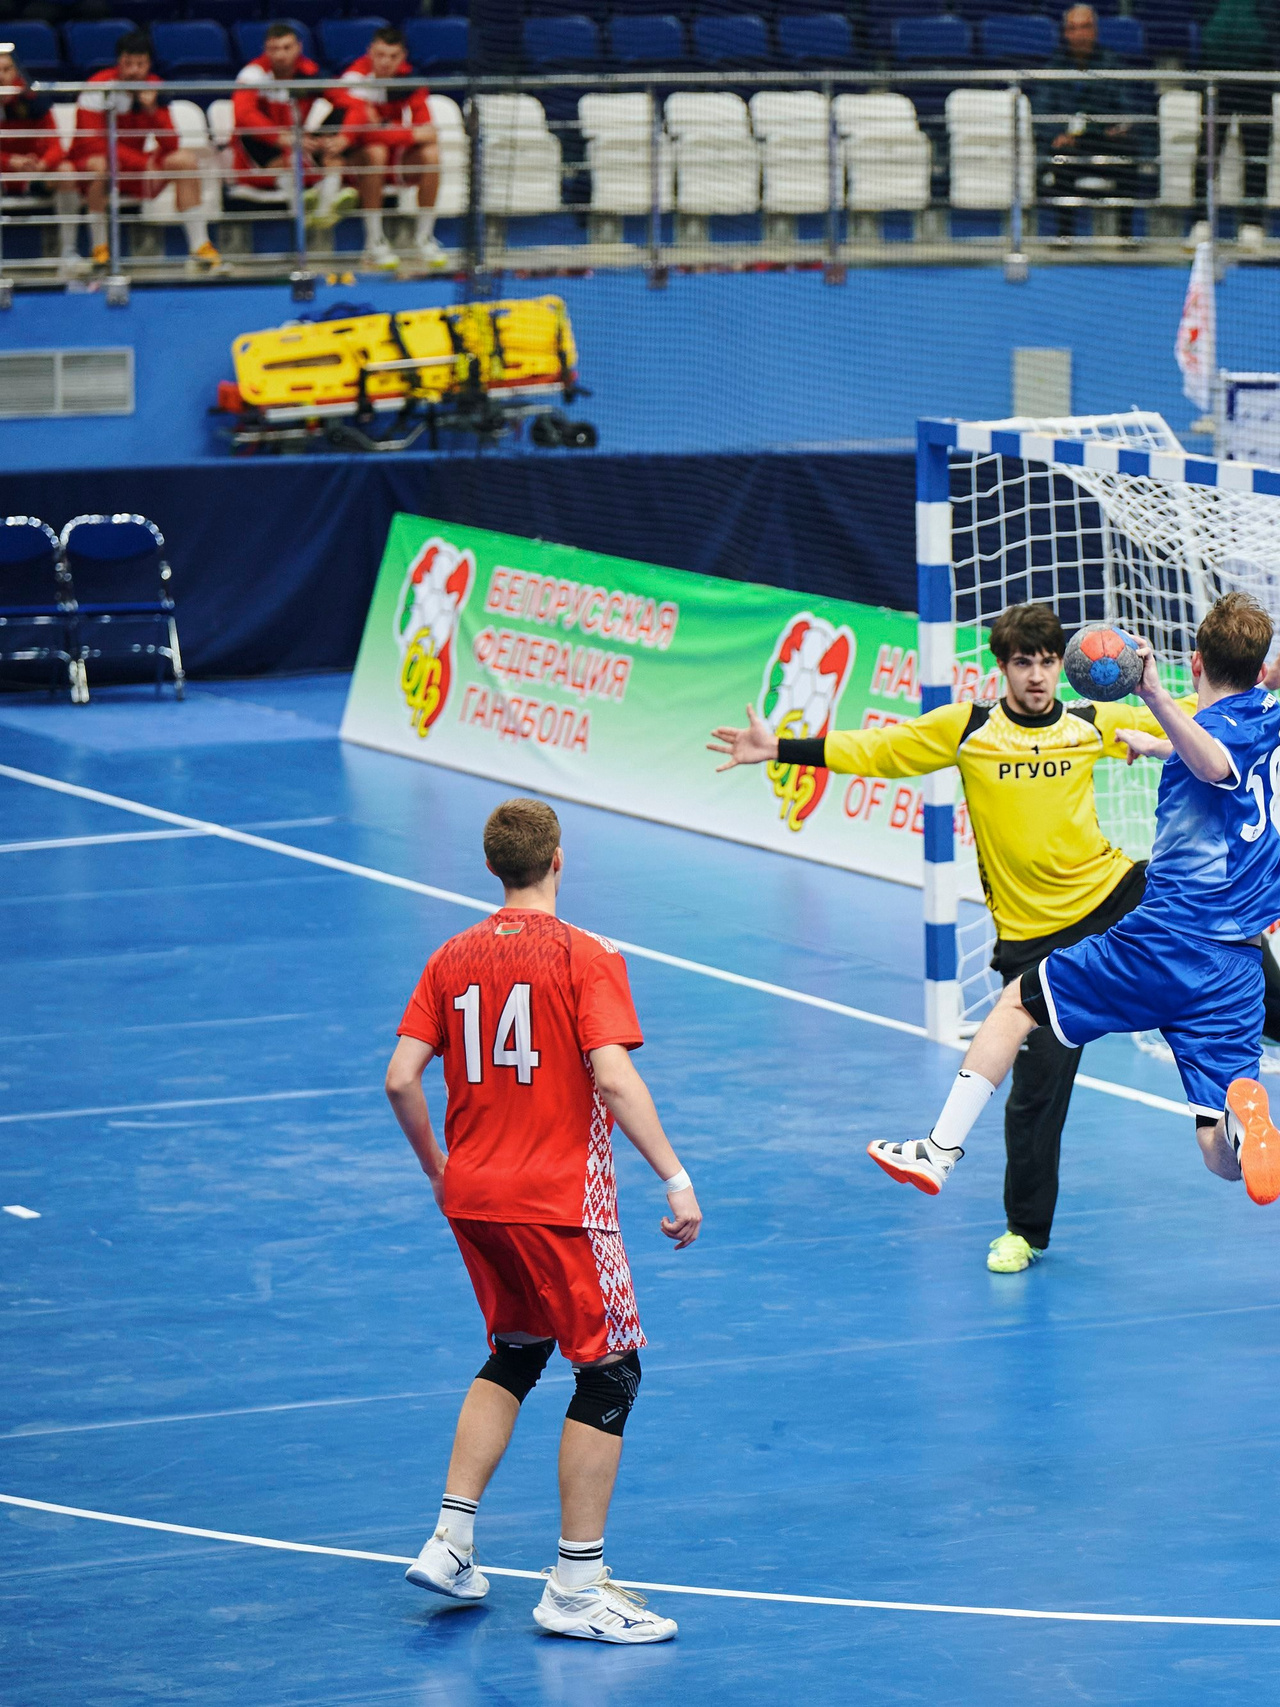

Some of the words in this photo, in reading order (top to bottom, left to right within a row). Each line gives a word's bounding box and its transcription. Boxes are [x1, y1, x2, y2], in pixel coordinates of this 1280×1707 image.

[487, 570, 677, 648] БЕЛОРУССКАЯ
[475, 631, 631, 702] ФЕДЕРАЦИЯ
[459, 684, 590, 751] ГАНДБОЛА
[844, 777, 887, 821] OF
[999, 760, 1072, 780] РГУОР
[1240, 750, 1280, 842] 5
[453, 982, 540, 1086] 14
